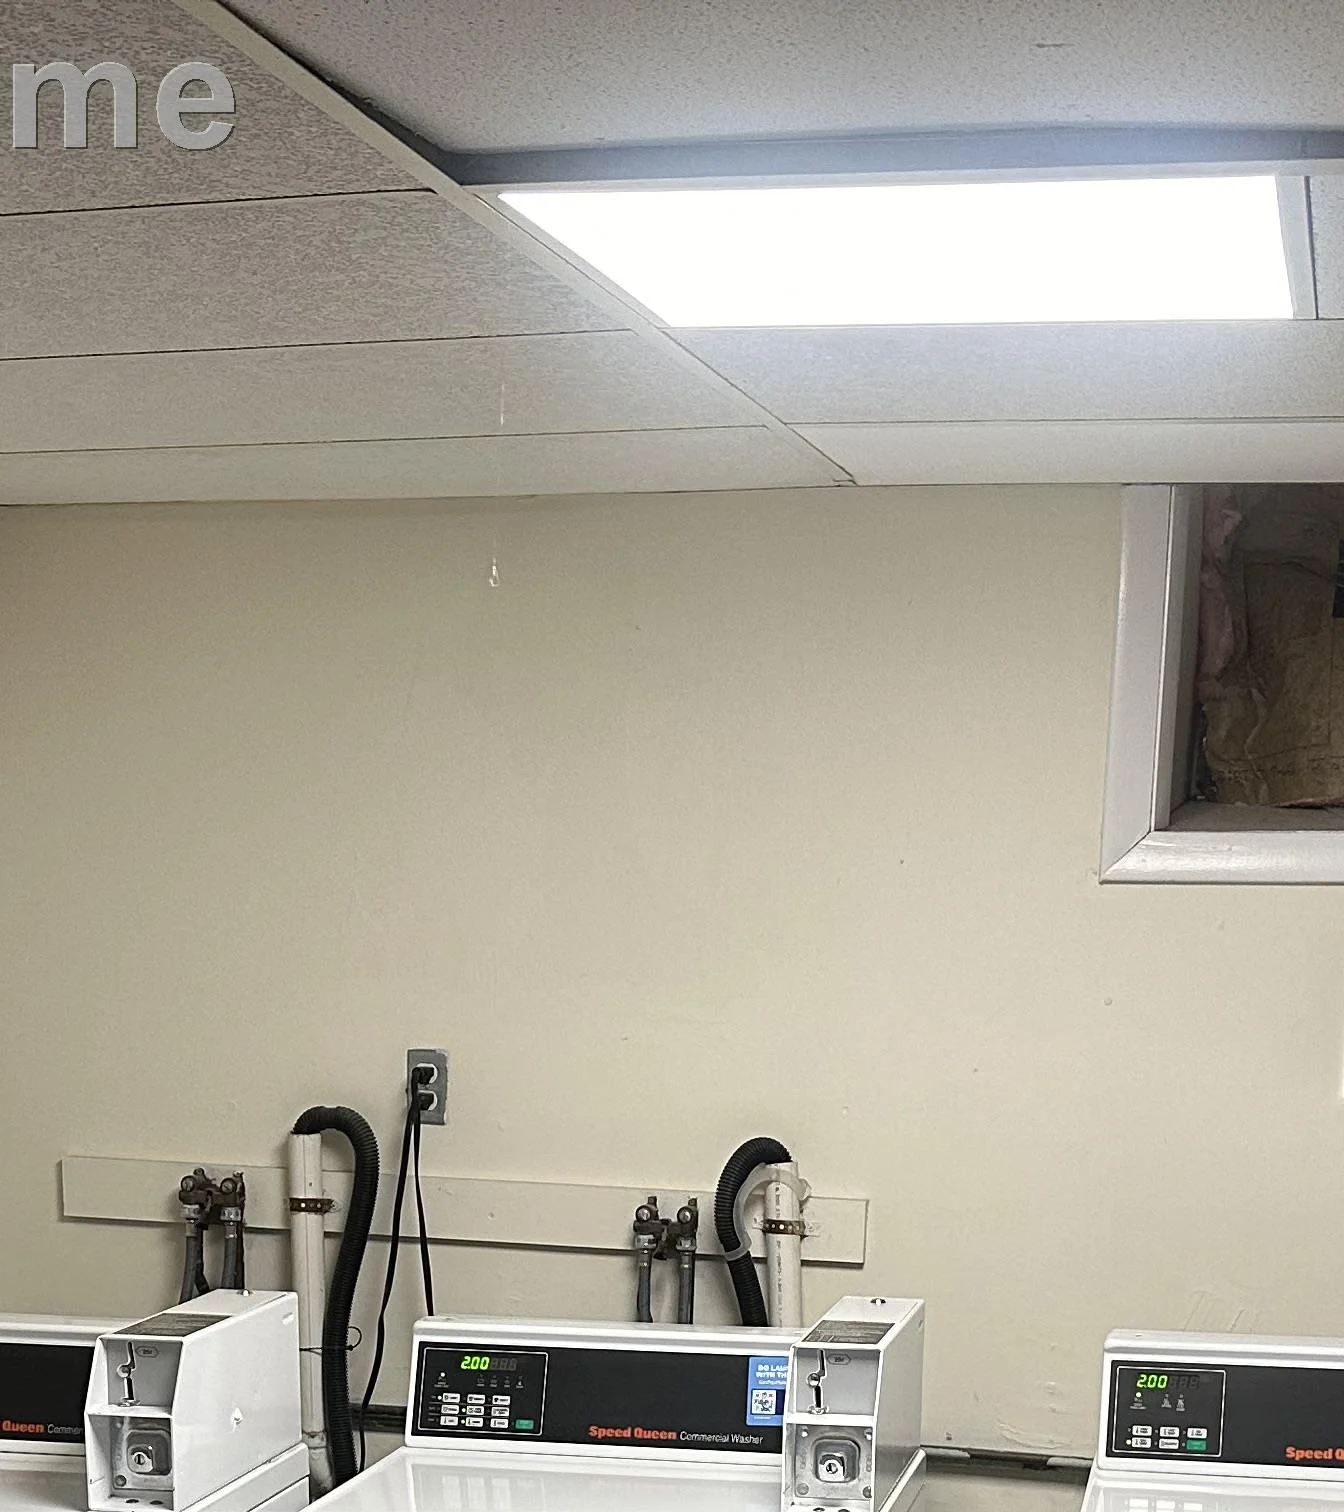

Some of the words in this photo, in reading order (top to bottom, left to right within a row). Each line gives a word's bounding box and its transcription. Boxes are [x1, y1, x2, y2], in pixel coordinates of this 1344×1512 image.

[460, 1355, 491, 1370] 2.00
[1136, 1374, 1168, 1389] 2.00
[2, 1420, 45, 1434] Queen
[589, 1425, 633, 1441] Speed
[634, 1428, 677, 1441] Queen
[679, 1430, 730, 1444] Commercial
[730, 1433, 764, 1446] Washer
[1285, 1446, 1333, 1462] Speed
